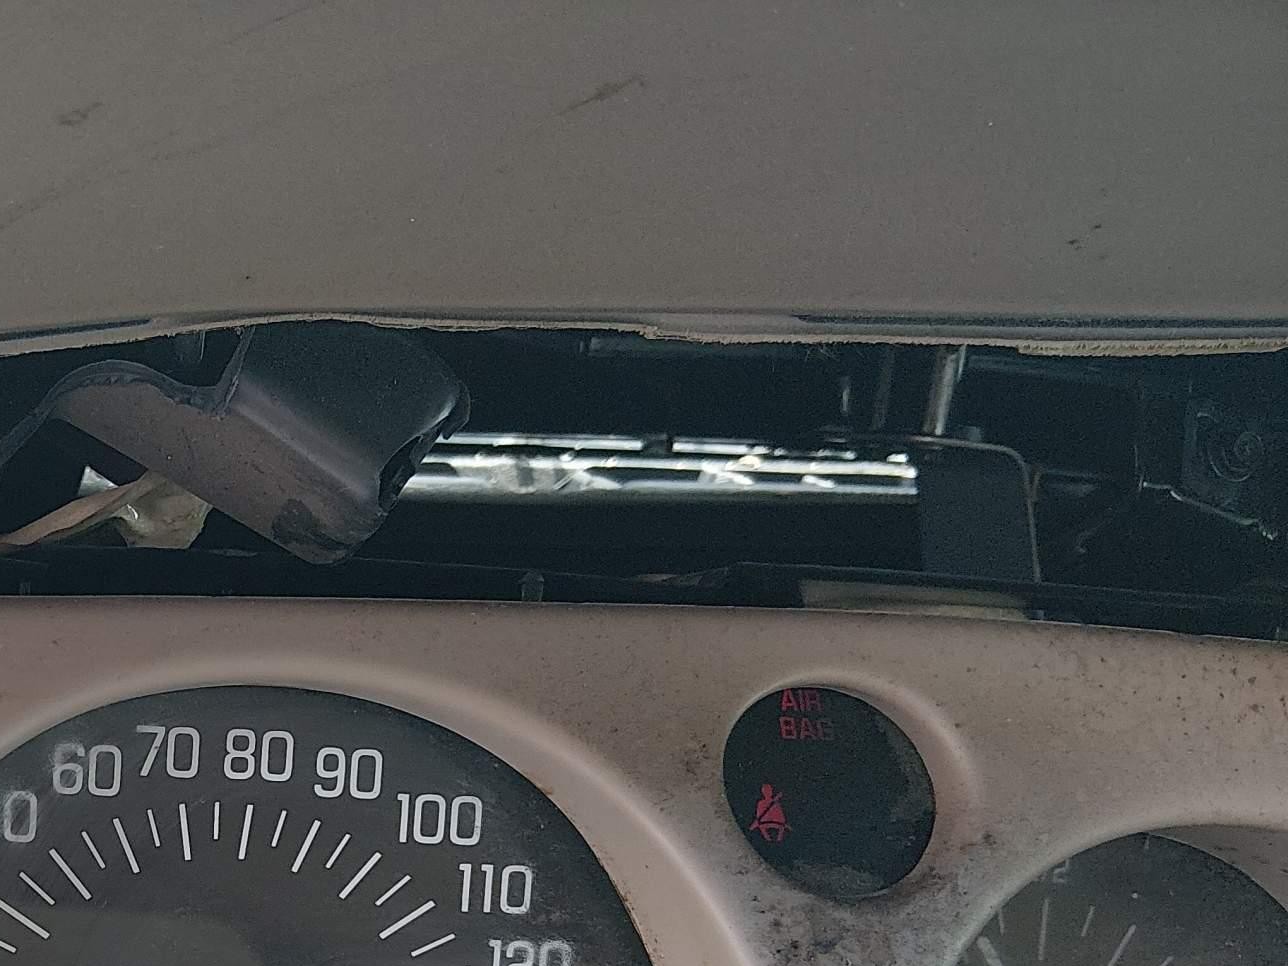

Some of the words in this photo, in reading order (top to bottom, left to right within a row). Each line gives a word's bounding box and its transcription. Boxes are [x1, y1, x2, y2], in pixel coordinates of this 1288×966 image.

[52, 743, 122, 796] 60
[136, 725, 200, 778] 70
[224, 728, 295, 781] 80
[314, 747, 383, 800] 90
[397, 793, 483, 845] 100
[459, 863, 533, 915] 110
